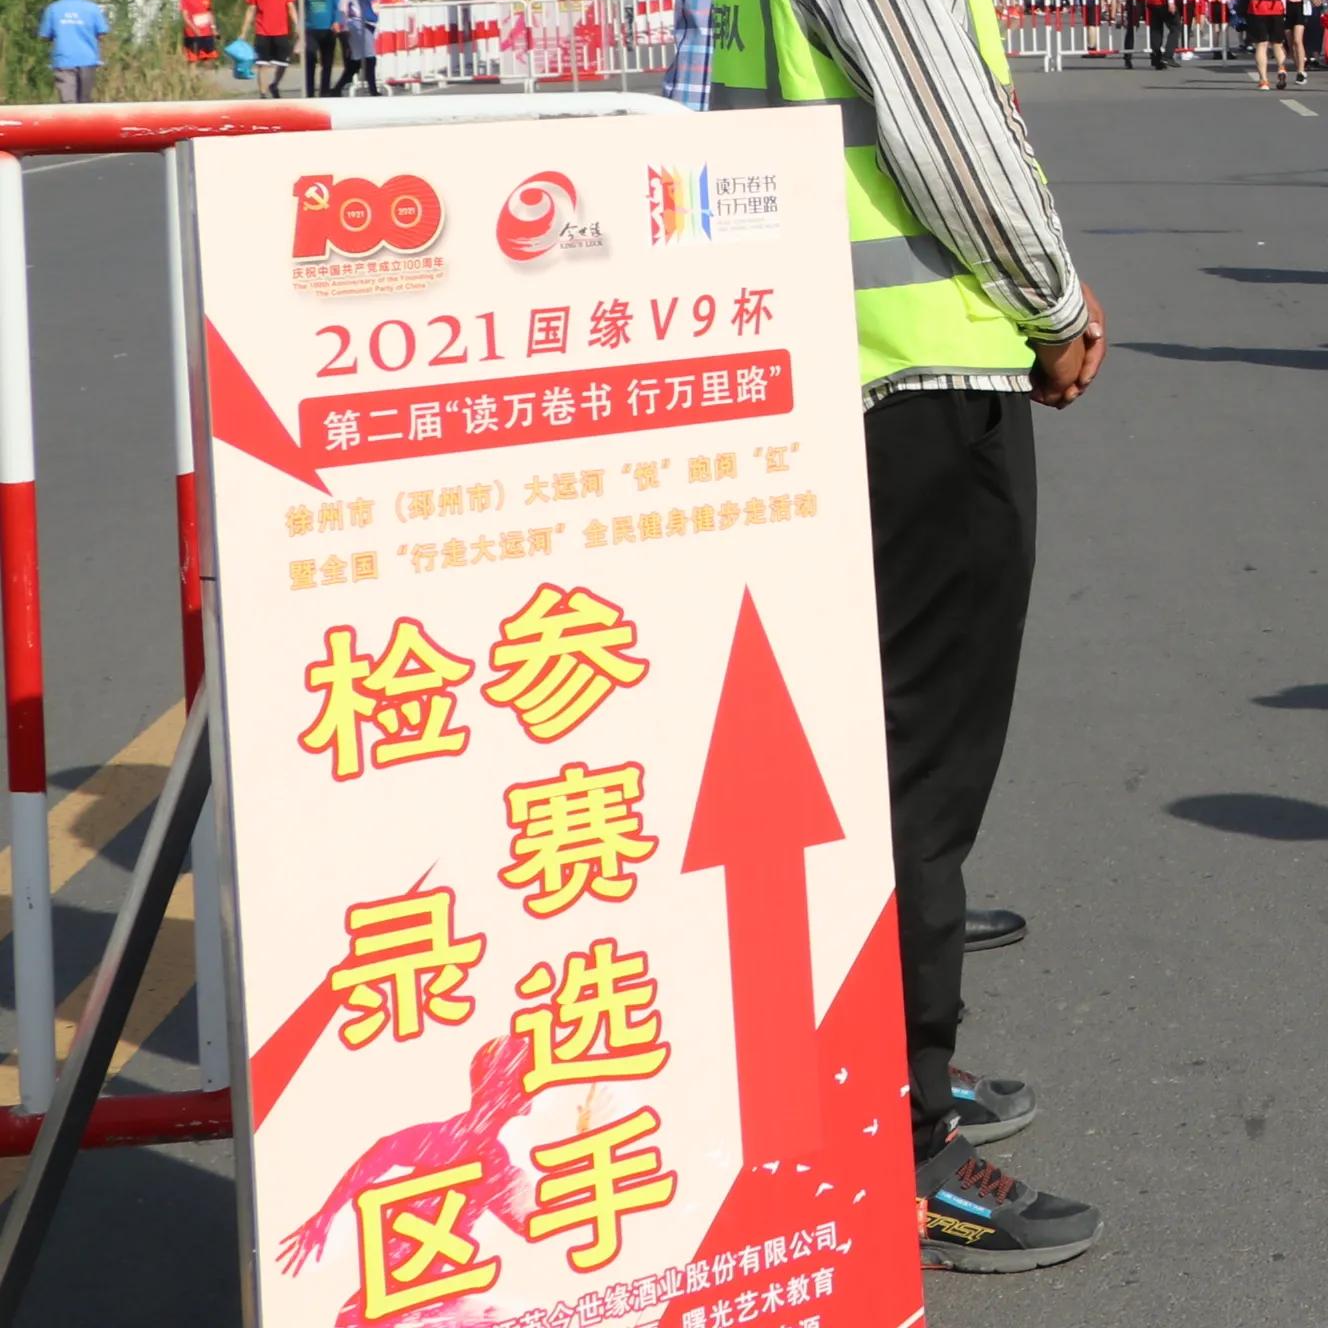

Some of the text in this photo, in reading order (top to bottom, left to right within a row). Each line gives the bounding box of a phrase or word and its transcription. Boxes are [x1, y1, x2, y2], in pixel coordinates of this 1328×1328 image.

[715, 174, 778, 196] 读万卷书
[716, 195, 779, 218] 行万里路
[315, 287, 775, 378] 2021国缘V9杯
[322, 364, 782, 453] 第二届“读万卷书 行万里路”
[492, 1220, 838, 1328] 苏今世缘酒业股份有限公司
